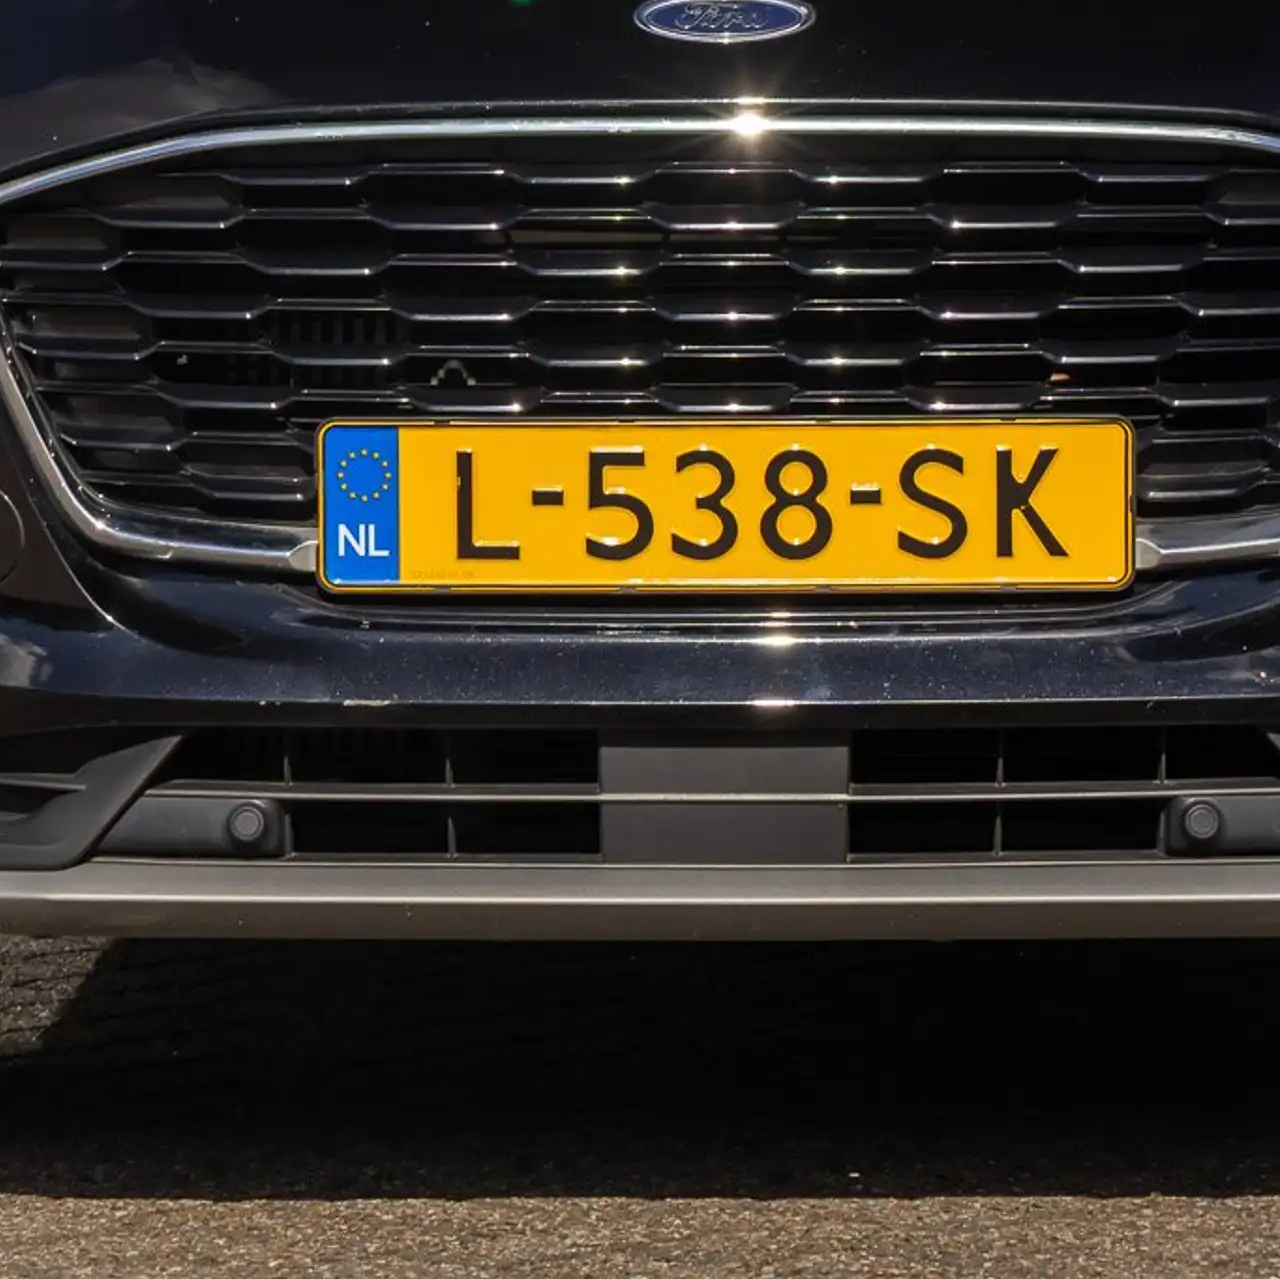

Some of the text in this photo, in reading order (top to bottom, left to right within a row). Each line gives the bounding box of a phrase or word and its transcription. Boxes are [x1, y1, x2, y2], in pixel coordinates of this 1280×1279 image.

[676, 1, 769, 30] Ford
[455, 446, 1068, 562] L-538-SK
[336, 524, 390, 557] NL
